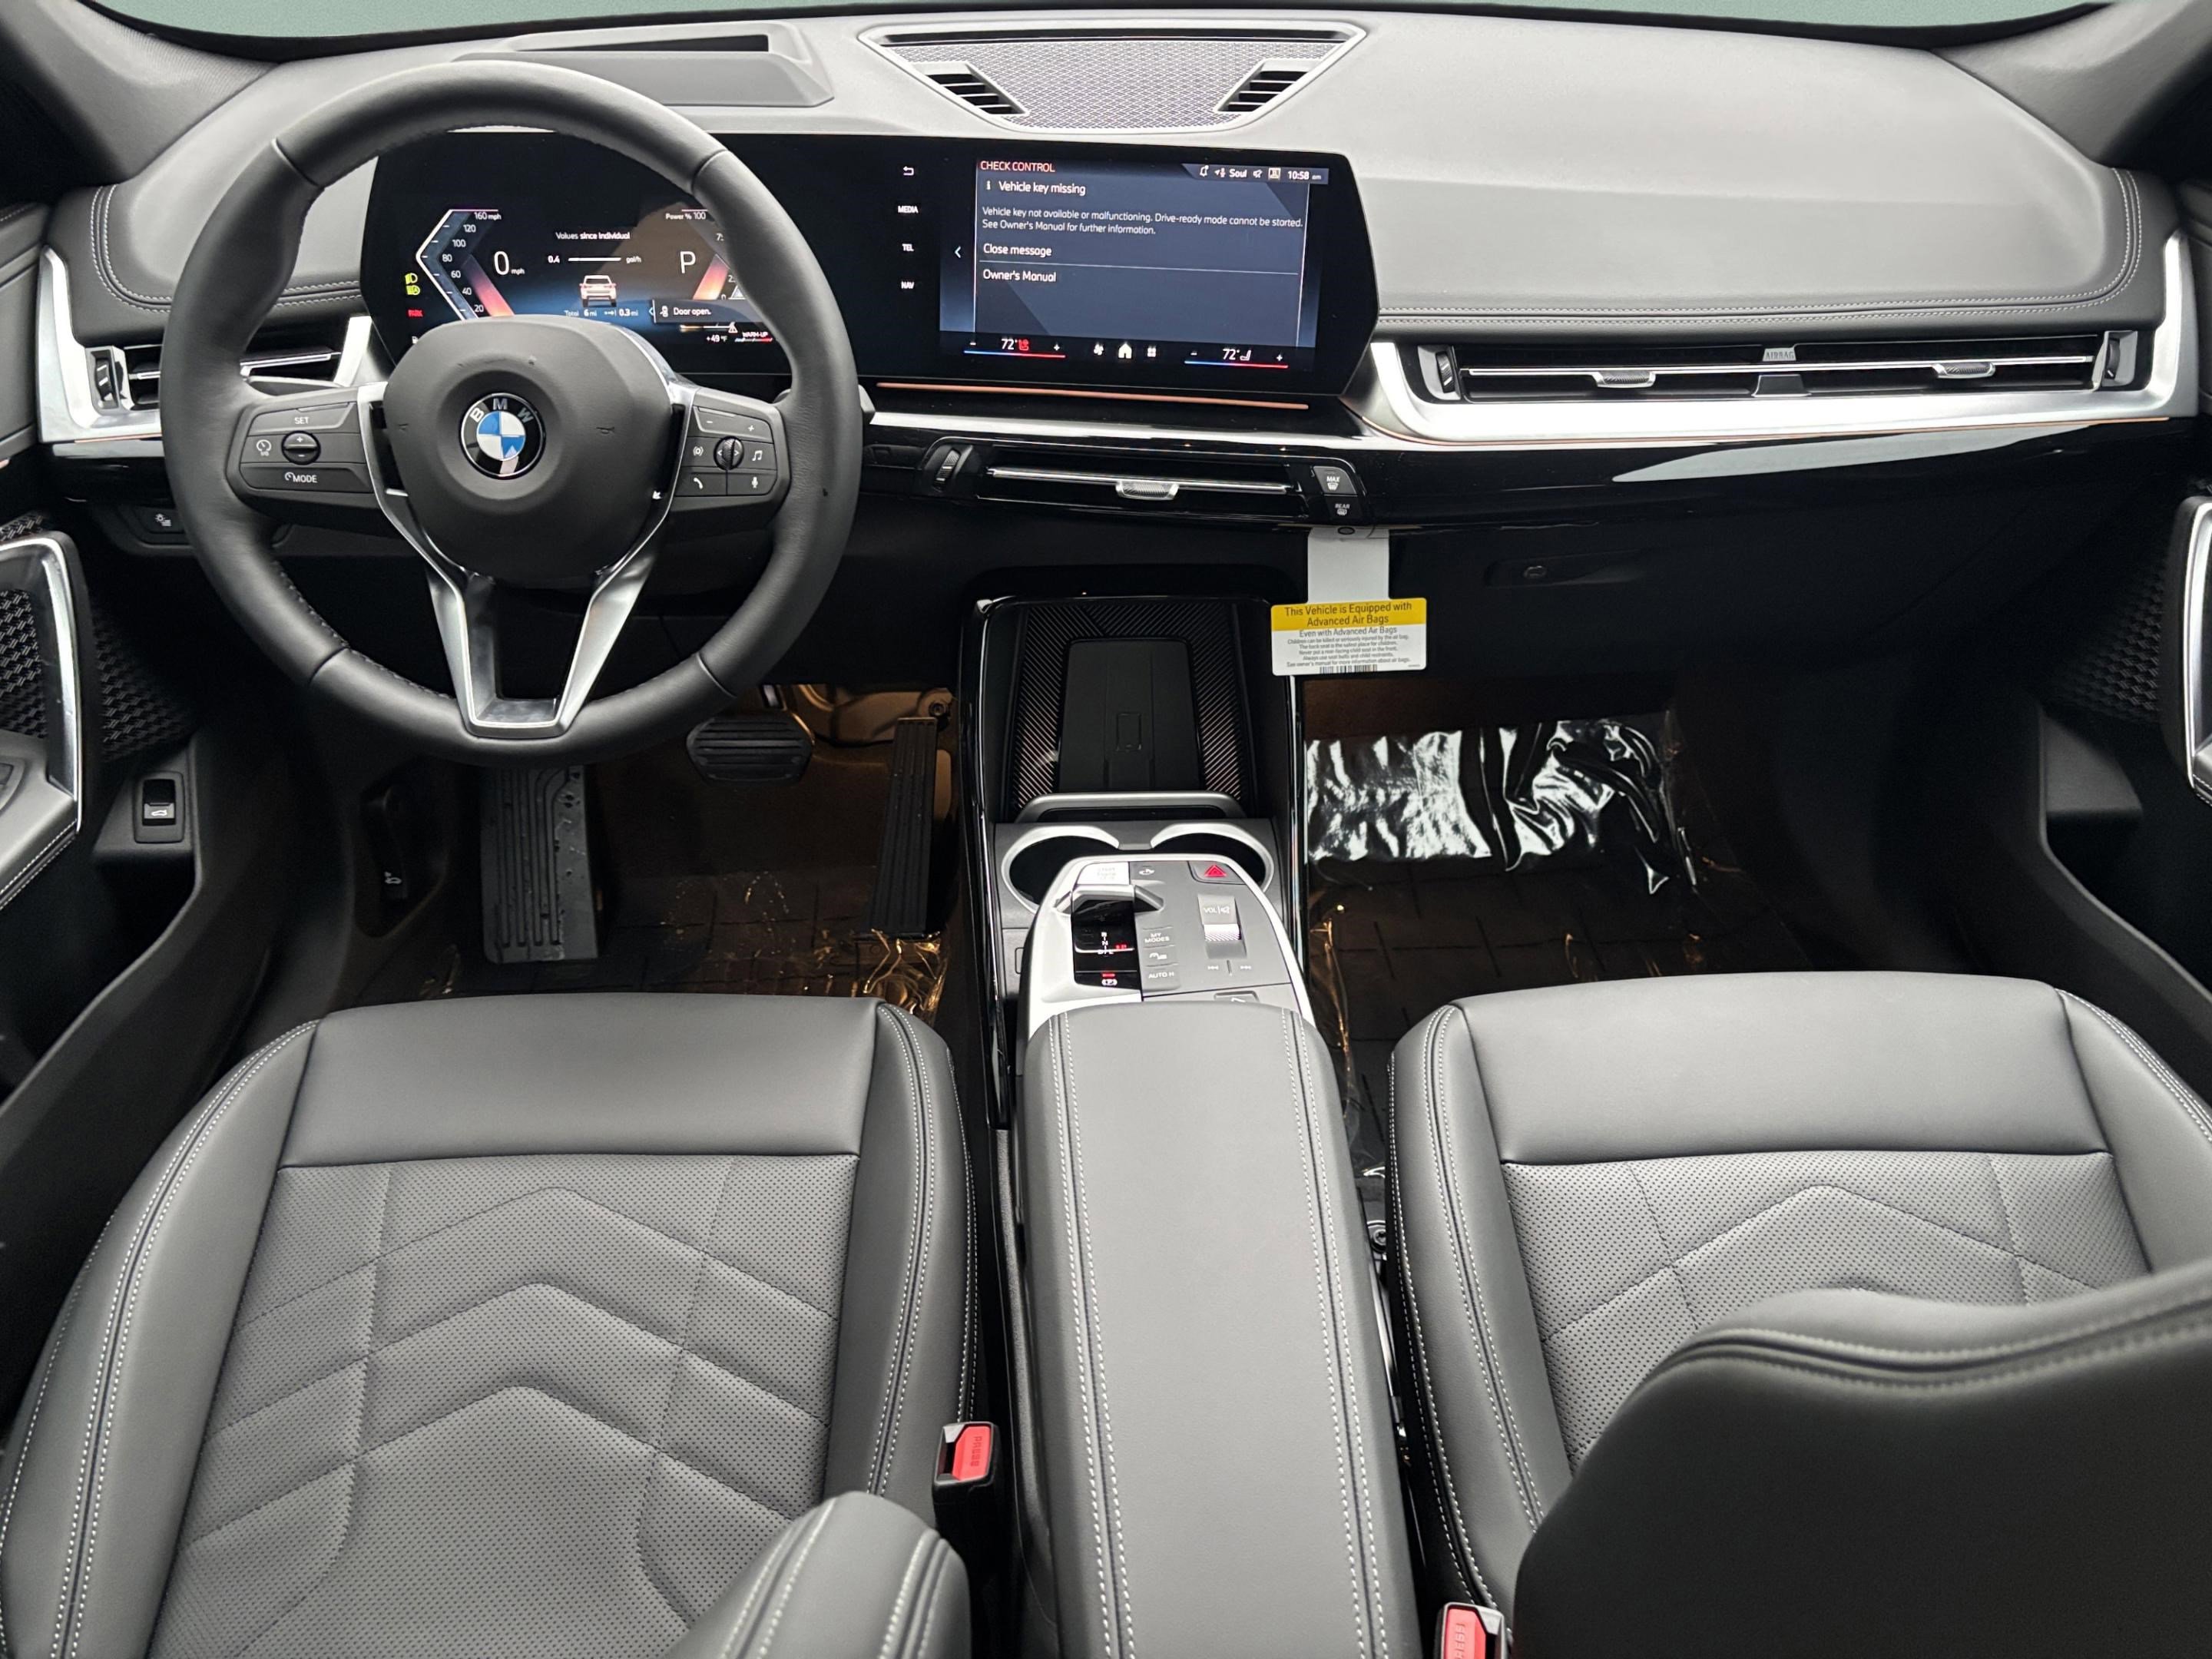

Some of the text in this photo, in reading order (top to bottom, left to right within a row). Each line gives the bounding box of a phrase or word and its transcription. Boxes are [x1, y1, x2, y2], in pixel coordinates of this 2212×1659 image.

[980, 161, 1056, 172] CHECK CONTROL
[1229, 168, 1247, 178] Soul
[1287, 171, 1310, 180] 10:58
[998, 180, 1031, 192] Vehicle
[1033, 182, 1048, 195] key
[1051, 183, 1086, 197] missing
[474, 211, 502, 221] 160 mph
[693, 212, 707, 220] 100
[982, 207, 1011, 217] Vehicle
[1012, 207, 1027, 218] key
[1028, 209, 1041, 217] not
[1043, 209, 1079, 219] available
[1091, 211, 1154, 224] malfunctioning.
[1154, 213, 1202, 225] Drive-ready
[1204, 214, 1227, 224] mode
[1230, 217, 1257, 226] cannot
[1259, 217, 1270, 226] be
[1271, 218, 1303, 227] started.
[463, 224, 476, 233] 120
[982, 220, 1156, 234] See Owner's Manual for further information.
[452, 239, 466, 248] 100
[983, 243, 1052, 257] Close message
[442, 253, 452, 263] 80
[494, 250, 525, 276] 0 mph
[548, 255, 561, 263] 0.4
[680, 250, 696, 274] P
[451, 270, 462, 279] 60
[983, 269, 1057, 283] Owner's Manual
[901, 281, 915, 290] NAV
[462, 287, 472, 296] 40
[474, 304, 485, 313] 20
[618, 308, 631, 316] 0.3
[674, 307, 711, 317] Door open.
[1766, 351, 1795, 359] AIRBAG
[469, 398, 534, 423] BMW
[293, 474, 318, 484] MODE
[1284, 601, 1412, 616] This Vehicle is Equipped with
[1307, 614, 1389, 627] Advanced Air Bags
[1333, 628, 1366, 636] Advanced
[1379, 626, 1398, 634] Bags
